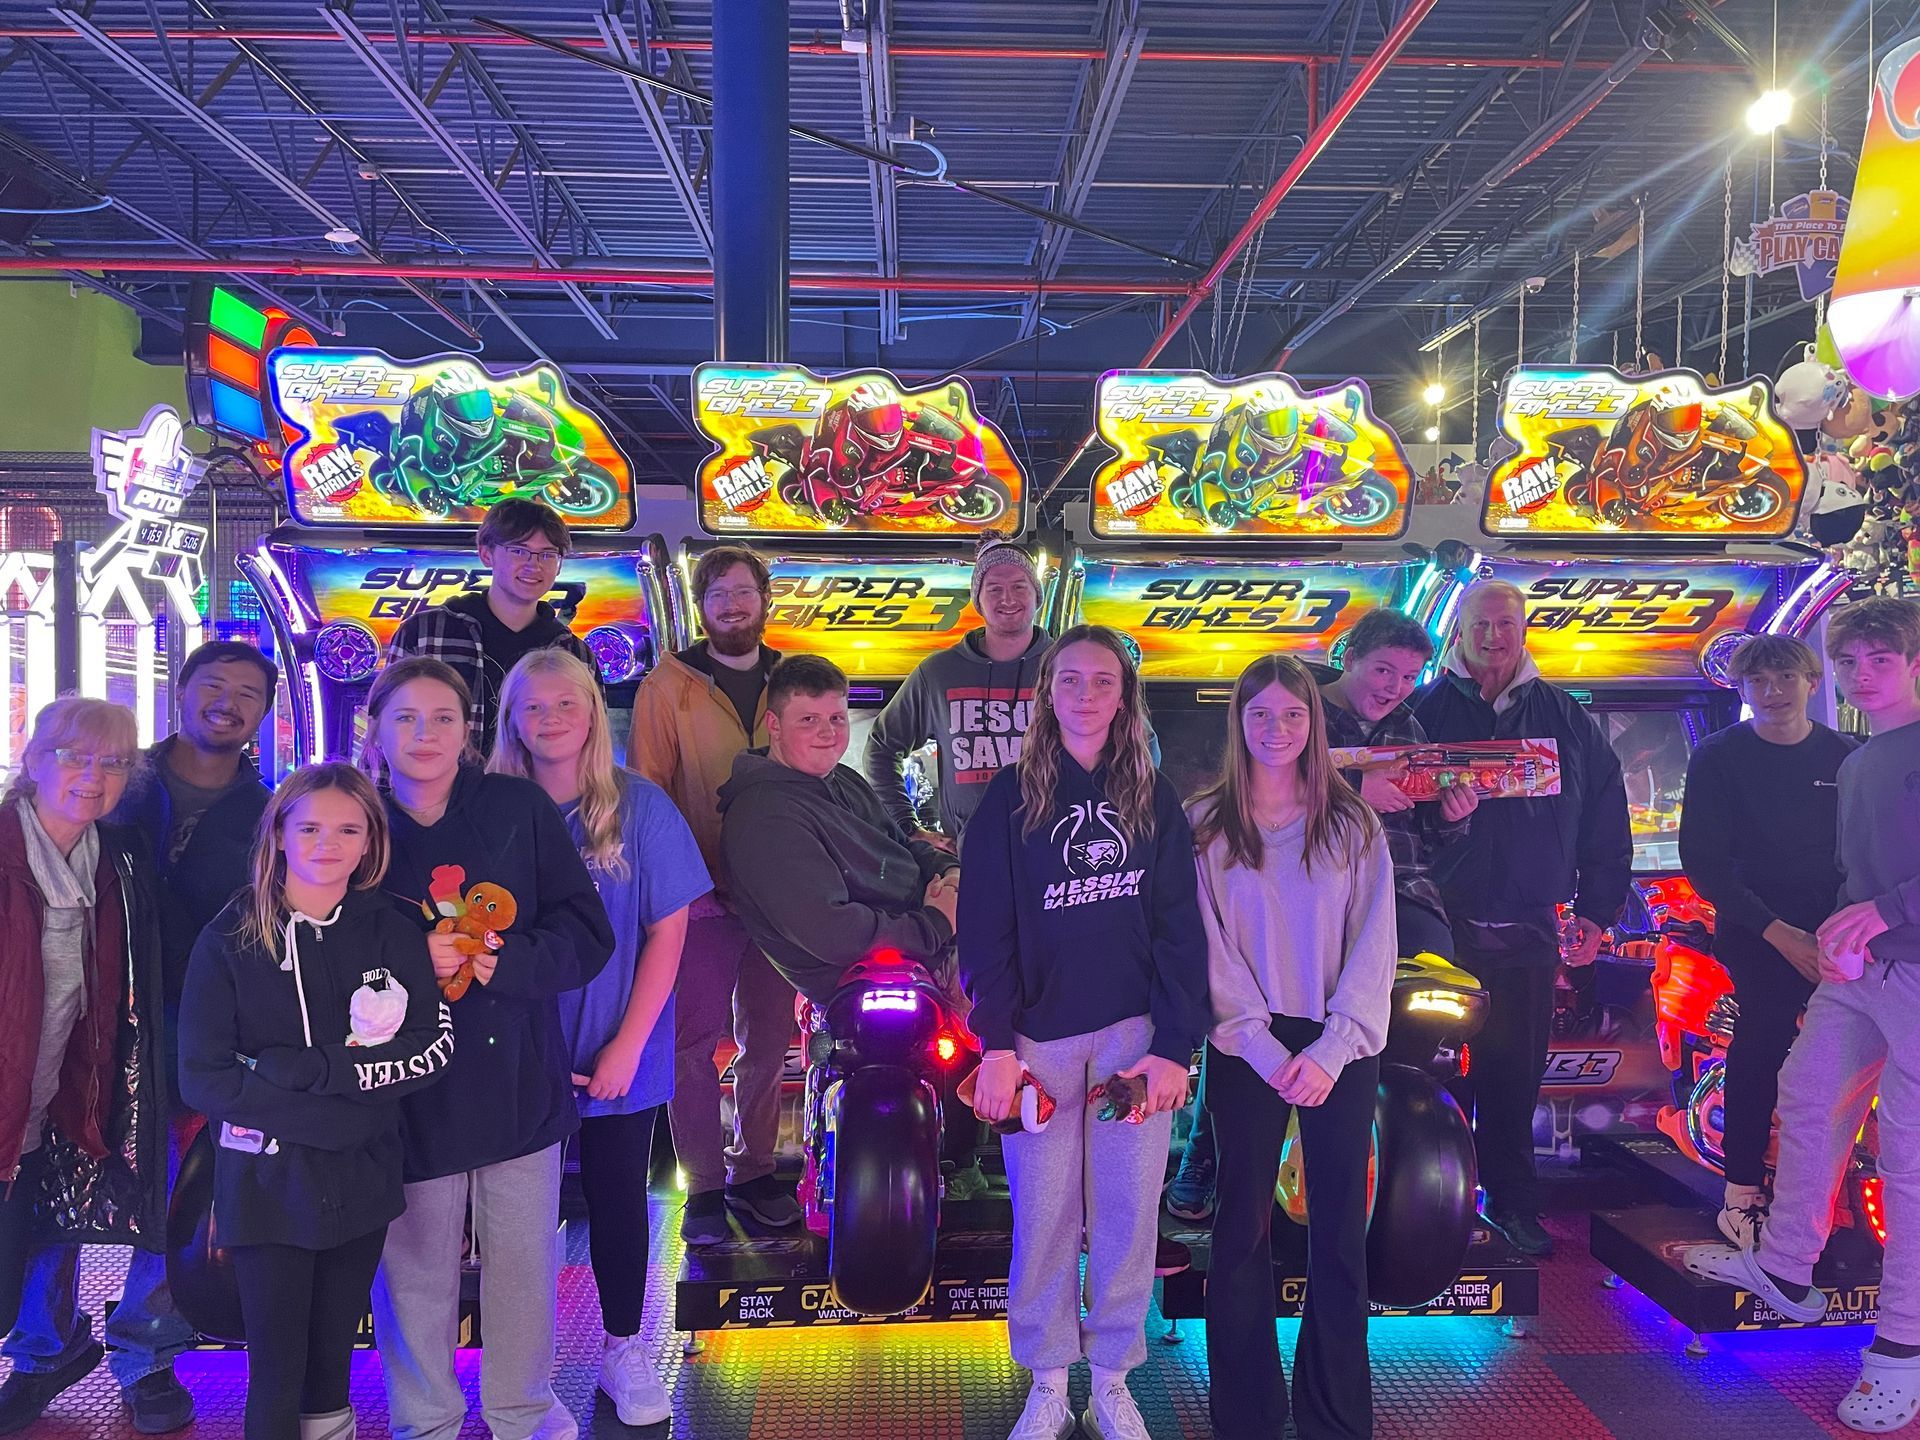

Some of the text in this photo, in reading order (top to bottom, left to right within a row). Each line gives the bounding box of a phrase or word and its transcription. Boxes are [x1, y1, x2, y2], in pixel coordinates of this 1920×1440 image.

[1775, 222, 1793, 230] The
[1796, 221, 1823, 230] Place
[1827, 222, 1837, 230] To
[1760, 235, 1841, 268] PLAY CA
[279, 364, 388, 385] SUPER
[284, 374, 416, 405] BIKES 3
[702, 379, 807, 400] SUPER
[705, 387, 833, 417] BIKES 3
[1104, 385, 1207, 405] SUPER
[1508, 380, 1612, 400] SUPER
[1510, 388, 1638, 419] BIKES 3
[1106, 392, 1232, 423] BIKES 3
[300, 443, 356, 489] RAW
[711, 455, 766, 500] RAW
[1105, 460, 1161, 501] RAW
[1502, 457, 1557, 502] RAW
[313, 463, 365, 500] THRILLS
[722, 475, 774, 510] THRILLS
[1508, 476, 1562, 514] THRILLS
[1113, 479, 1166, 516] THRILLS
[360, 567, 494, 592] SUPE
[769, 576, 925, 602] SUPER
[1140, 578, 1305, 601] SUPER
[1525, 577, 1690, 602] SUPER
[768, 588, 971, 632] BIKES 3
[1142, 589, 1352, 634] BIKES 3
[1526, 588, 1735, 633] BIKES 3
[949, 699, 1033, 734] JESU
[951, 736, 1023, 770] SAV
[1043, 884, 1140, 910] BASKETBAL
[740, 1295, 774, 1308] STAY
[948, 1287, 975, 1299] ONE
[1428, 1295, 1488, 1307] AT A TIME
[1454, 1284, 1491, 1295] RIDER
[739, 1306, 775, 1320] BACK
[951, 1300, 968, 1311] AT
[970, 1299, 980, 1310] A
[1825, 1310, 1880, 1321] WATCH YO
